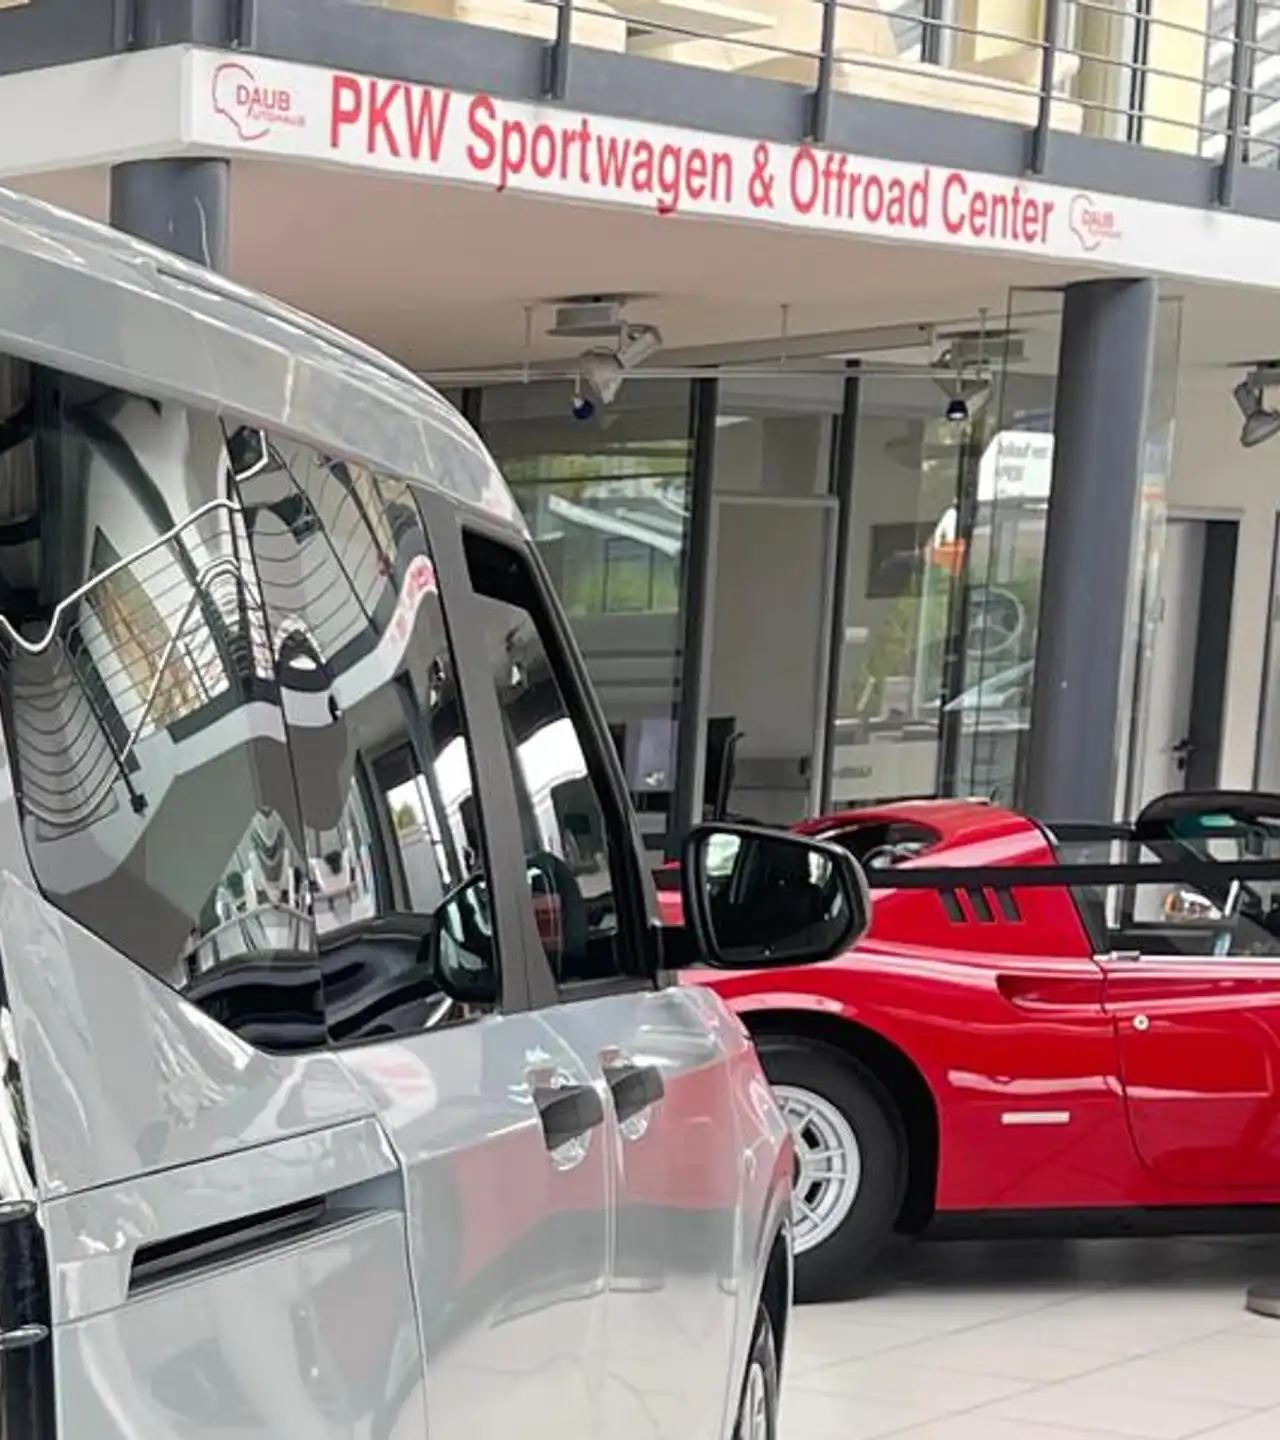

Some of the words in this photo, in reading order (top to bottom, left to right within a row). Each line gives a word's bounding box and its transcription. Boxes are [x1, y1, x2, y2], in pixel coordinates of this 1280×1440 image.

[236, 84, 290, 114] DAUB
[331, 74, 451, 163] PKW
[466, 93, 733, 214] Sportwagen
[747, 142, 774, 210] &
[790, 146, 930, 230] Offroad
[941, 171, 1055, 245] Center
